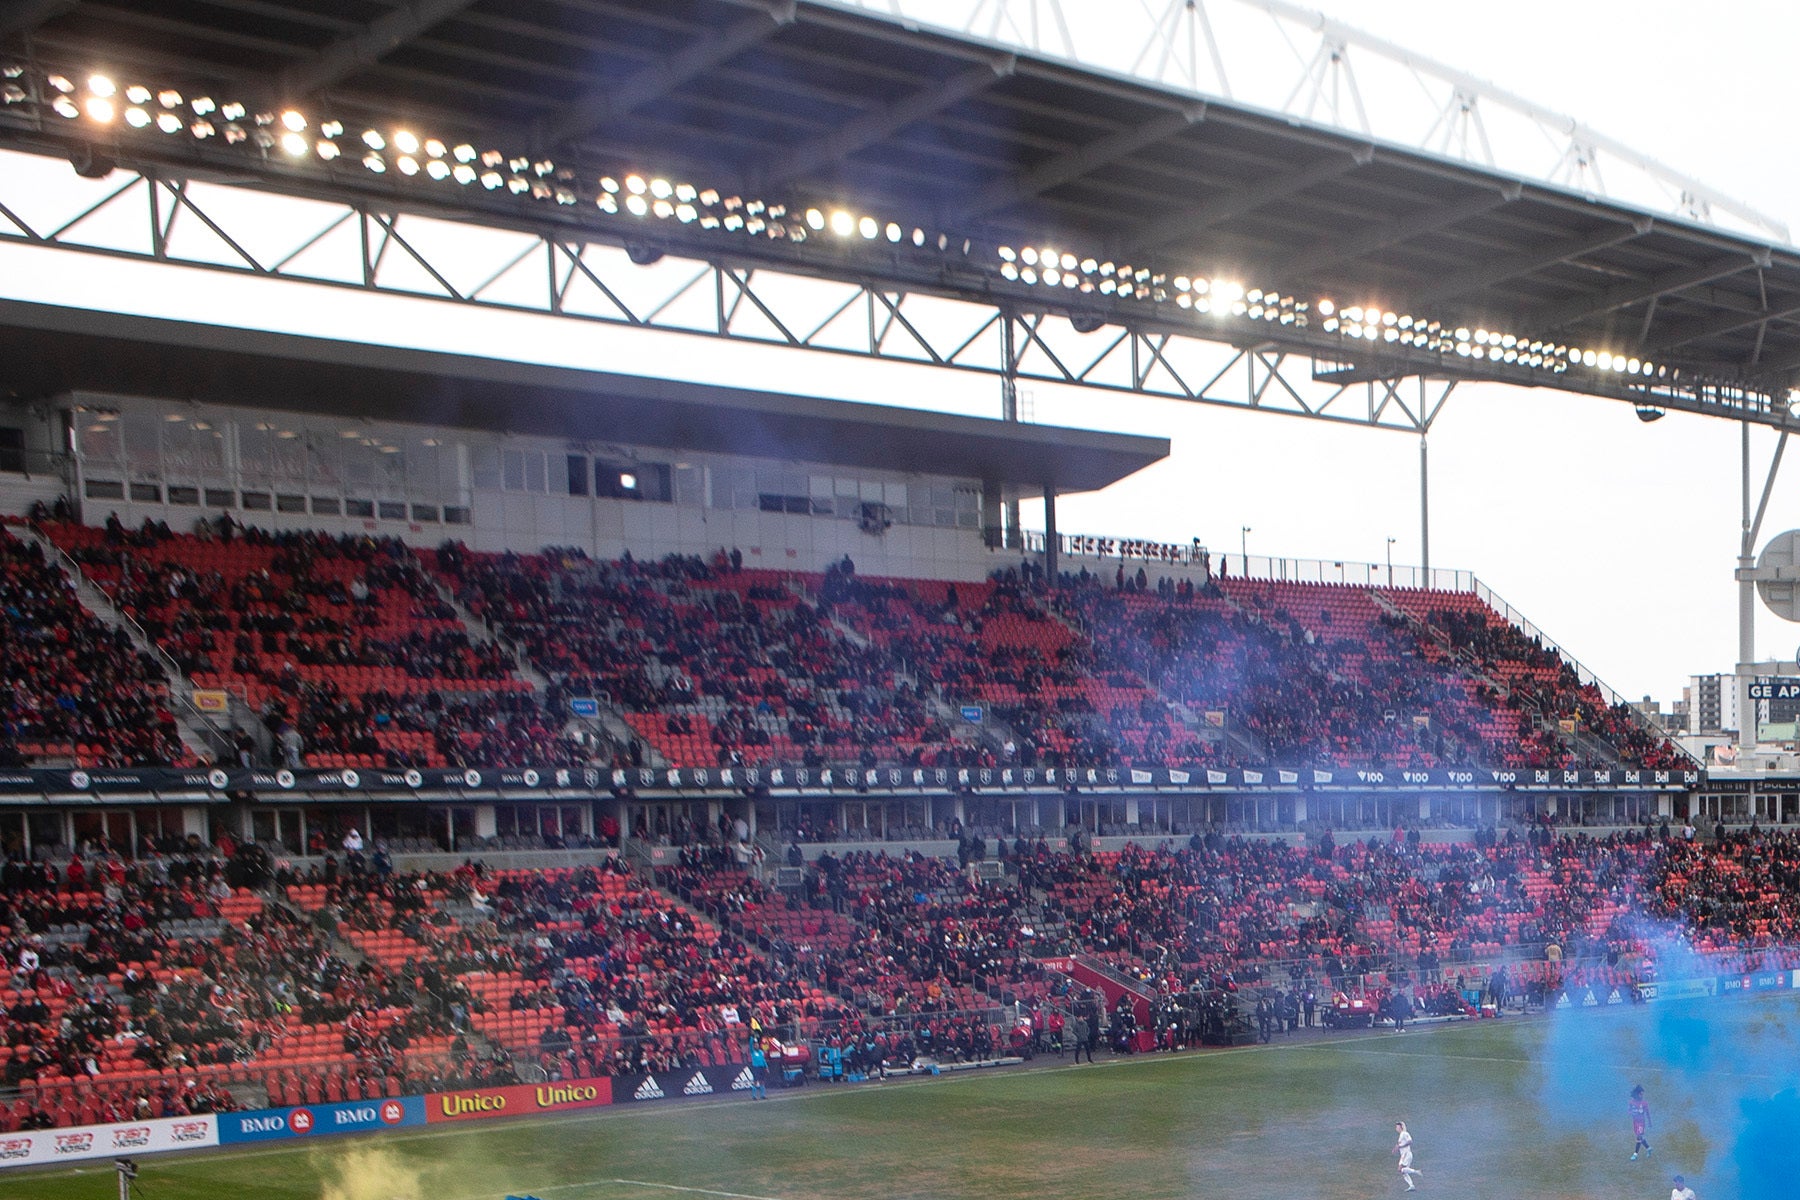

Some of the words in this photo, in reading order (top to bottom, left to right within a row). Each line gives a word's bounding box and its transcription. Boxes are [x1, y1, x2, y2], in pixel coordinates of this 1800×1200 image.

[1751, 685, 1772, 697] GE
[1367, 772, 1384, 782] 100
[1412, 772, 1429, 782] 100
[1456, 772, 1473, 782] 100
[1499, 772, 1516, 782] 100
[1535, 770, 1549, 783] Bell
[1564, 770, 1578, 783] Bell
[1595, 770, 1610, 783] Bell
[1625, 770, 1640, 783] Bell
[1655, 770, 1669, 783] Bell
[1684, 770, 1697, 783] Bell
[1725, 981, 1740, 990] BMO
[1759, 978, 1774, 986] BMO
[536, 1084, 597, 1107] Unico
[634, 1089, 665, 1099] adidas
[683, 1084, 714, 1095] adidas
[441, 1094, 506, 1117] Unico
[334, 1107, 376, 1125] BMO
[172, 1121, 208, 1133] TSN
[240, 1116, 284, 1133] BMO
[56, 1132, 94, 1146] TSN
[113, 1127, 151, 1139] TSN
